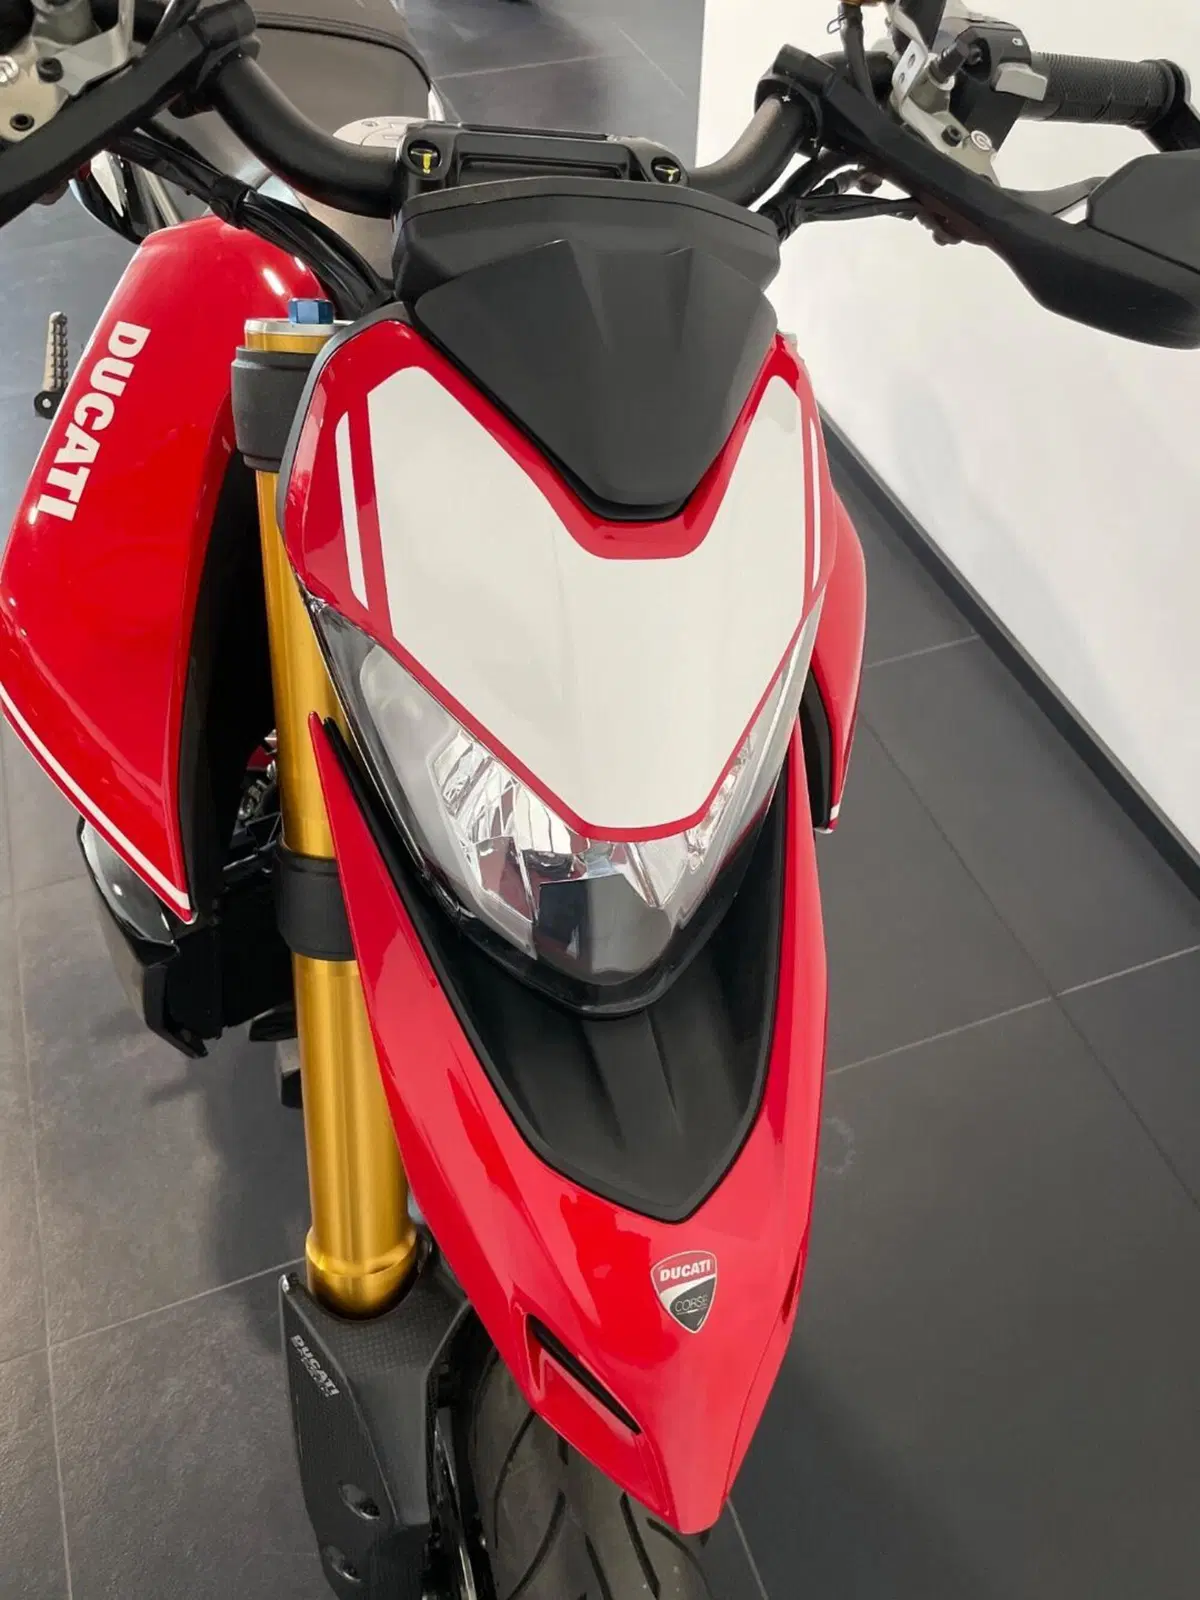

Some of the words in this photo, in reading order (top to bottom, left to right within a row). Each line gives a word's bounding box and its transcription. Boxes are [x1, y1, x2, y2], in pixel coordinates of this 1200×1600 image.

[36, 321, 151, 522] DUCATI
[660, 1259, 712, 1282] DUCATI
[675, 1295, 708, 1312] CORSE
[291, 1334, 340, 1395] DUCATI
